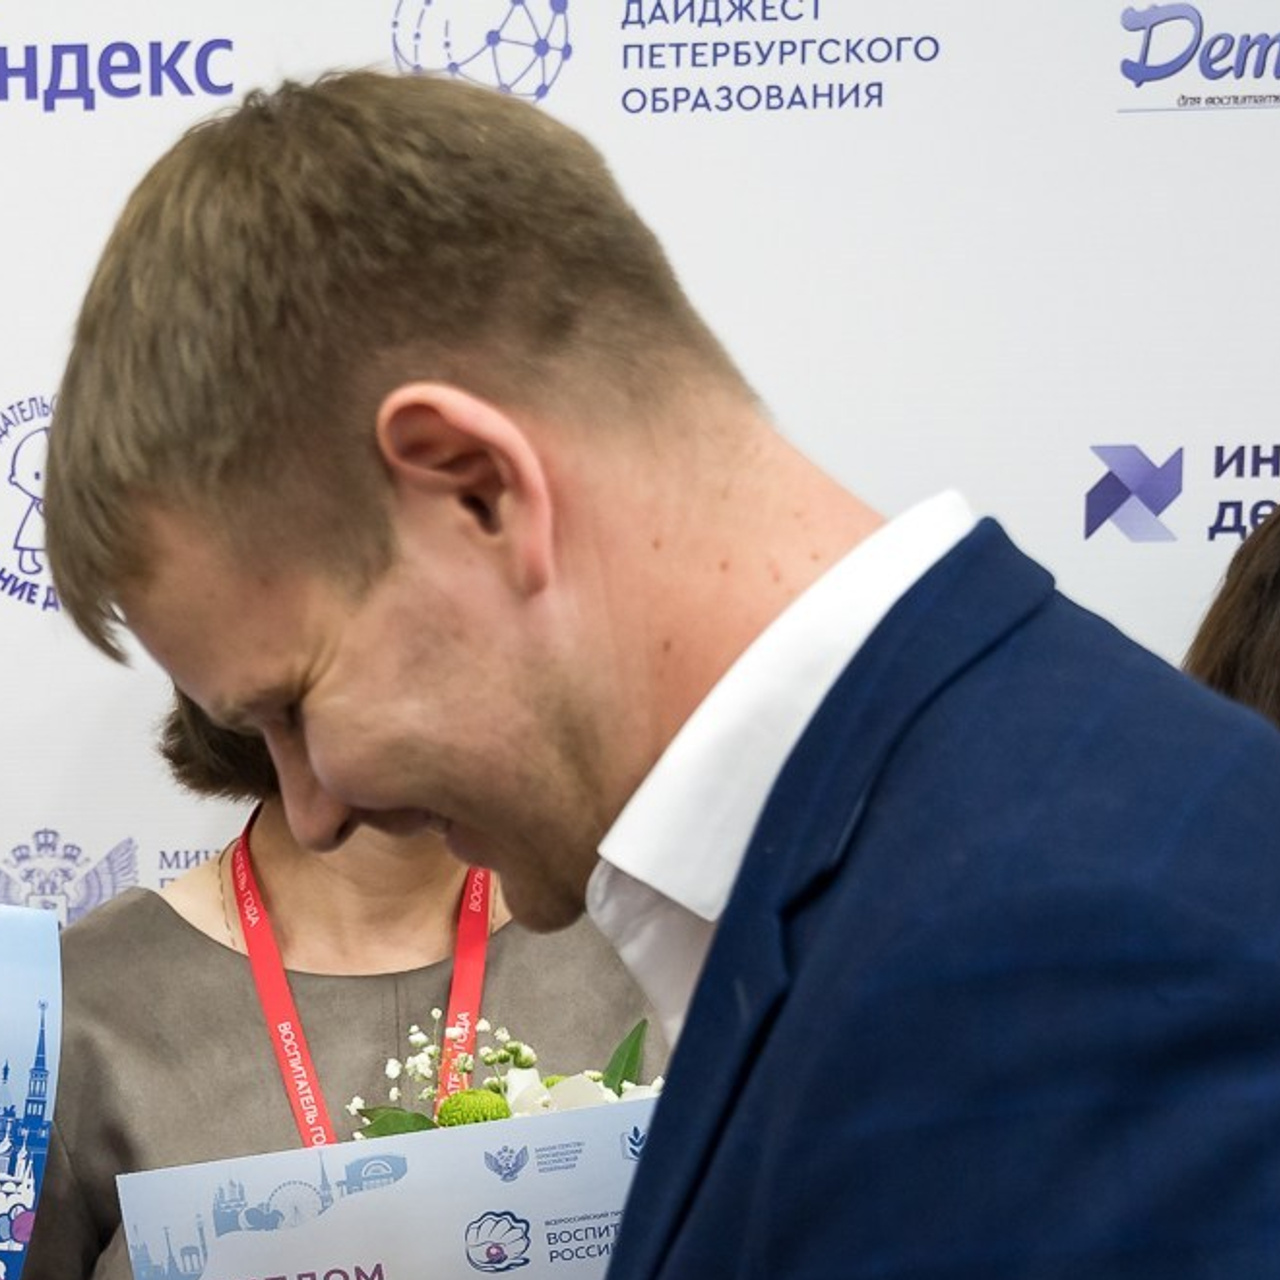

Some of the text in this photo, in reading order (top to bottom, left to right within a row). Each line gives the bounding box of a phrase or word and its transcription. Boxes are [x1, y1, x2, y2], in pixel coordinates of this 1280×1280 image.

[622, 36, 940, 69] ПЕТЕРБУРГСКОГО
[621, 82, 884, 114] ОБРАЗОВАНИЯ
[277, 1021, 318, 1125] ВОСПИТАТЕЛЬ
